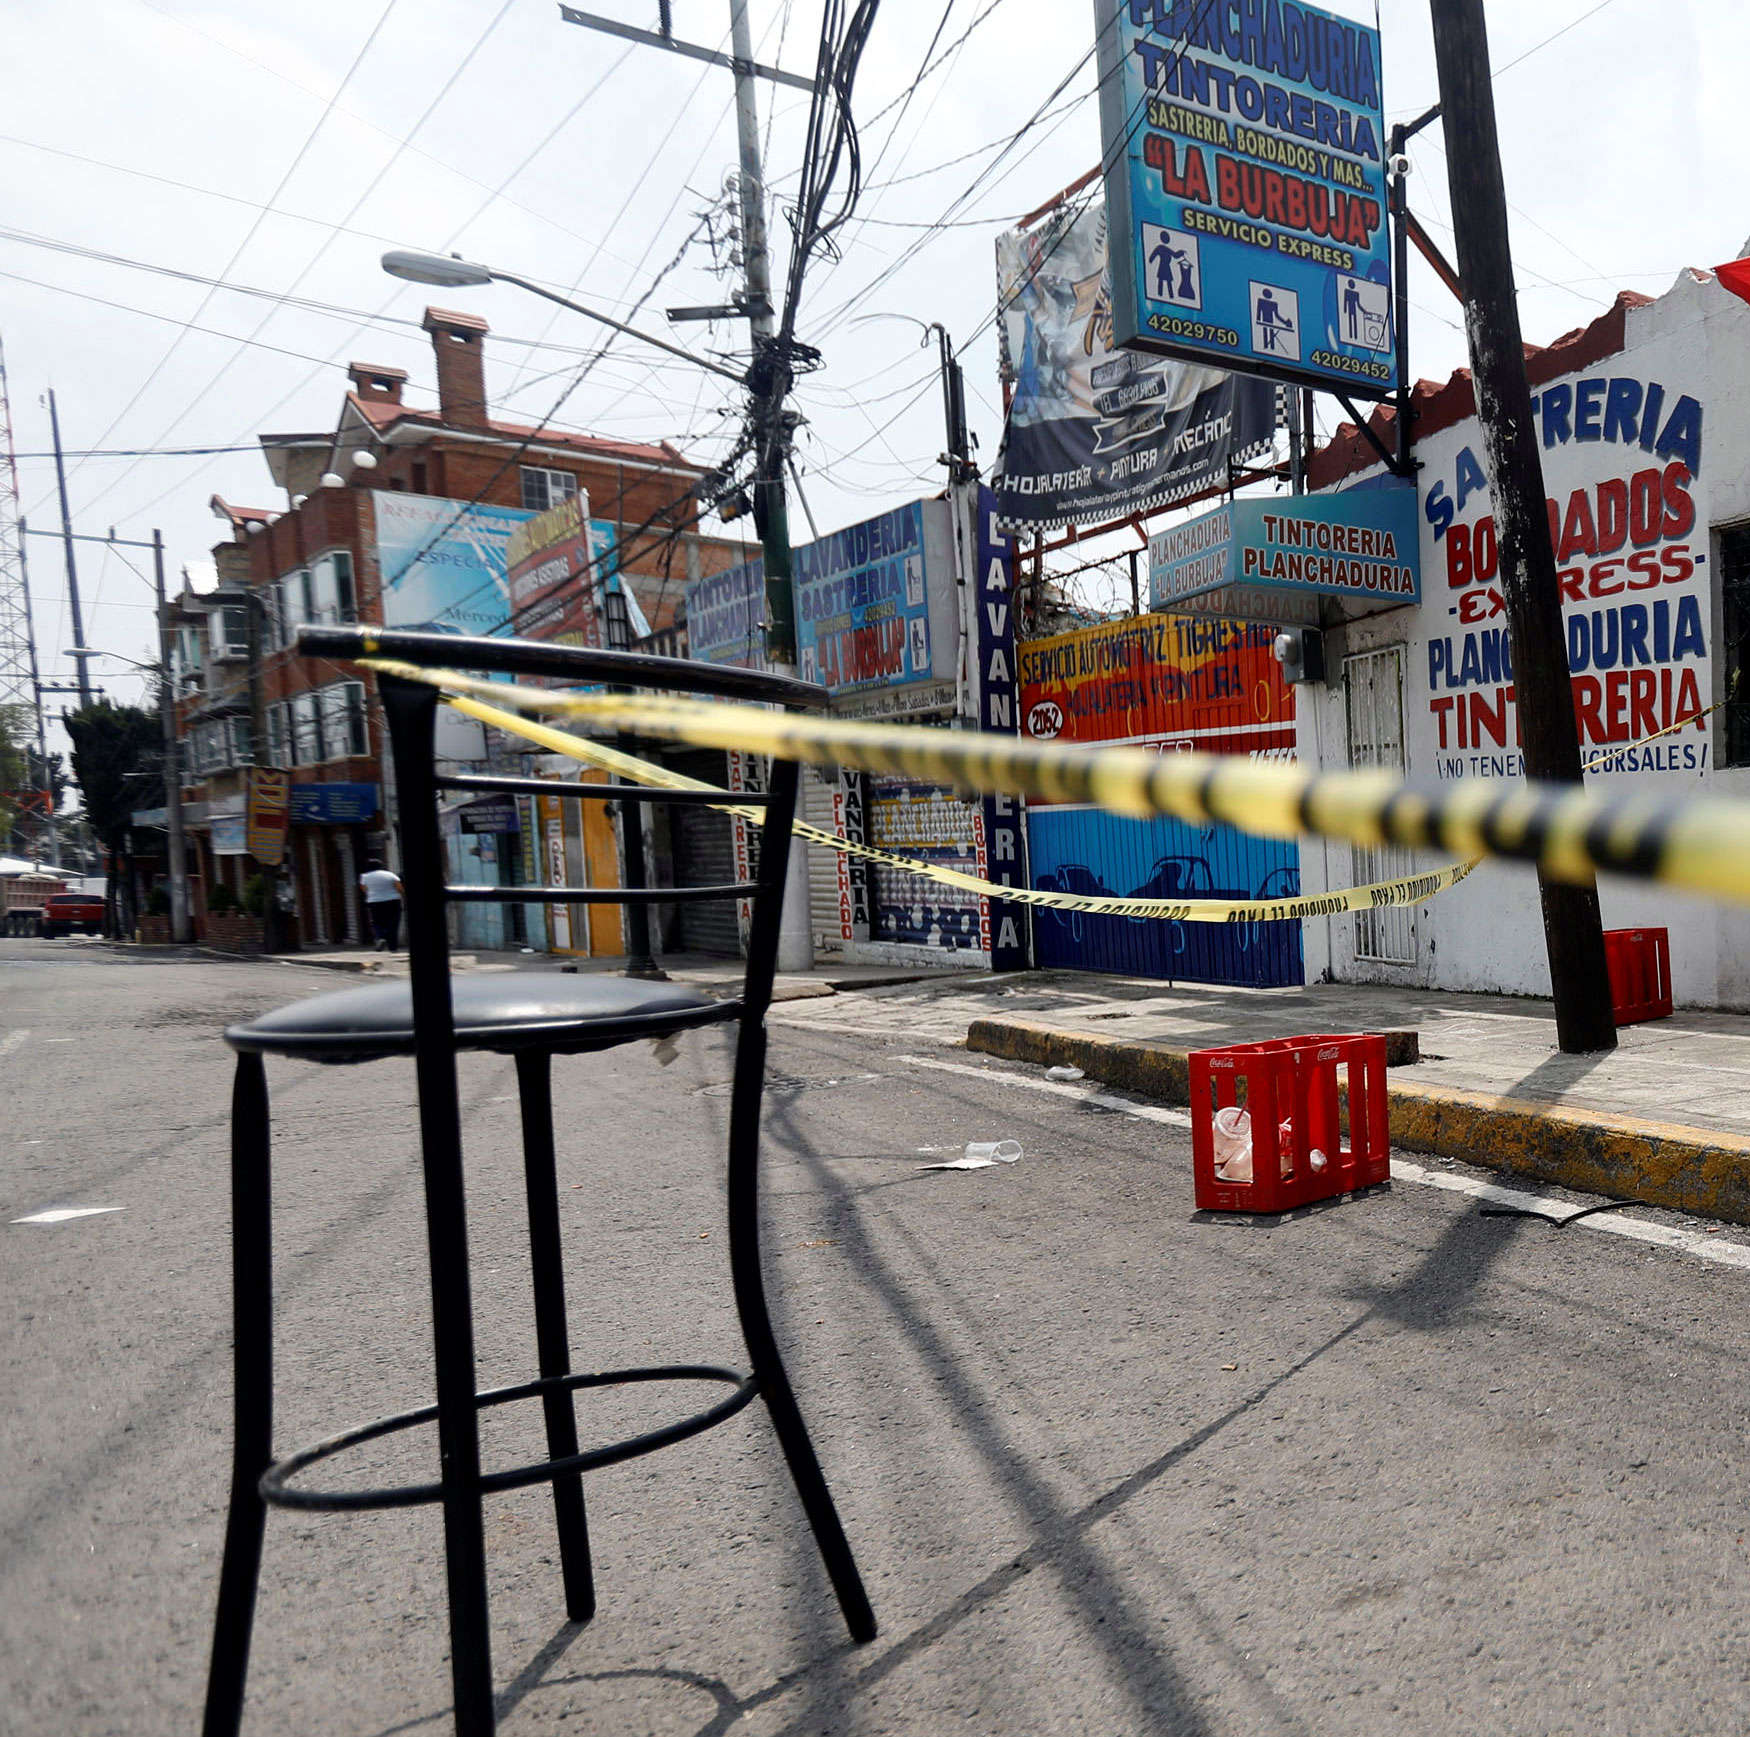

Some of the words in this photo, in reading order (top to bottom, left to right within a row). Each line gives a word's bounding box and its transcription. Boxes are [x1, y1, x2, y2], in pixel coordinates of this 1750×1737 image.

[1134, 39, 1379, 161] TINTORERIA
[1148, 101, 1232, 149] SASTRERIA,
[1236, 127, 1316, 174] BORDADOS
[1319, 156, 1331, 180] Y
[1184, 209, 1272, 249] SERVICIO
[1277, 231, 1353, 271] EXPRESS
[1148, 314, 1238, 347] 42029750
[1311, 349, 1389, 381] 42029452
[1110, 448, 1159, 480] PINTURA
[1425, 377, 1703, 543] SARERIA
[799, 503, 918, 584] LAVANDERIA
[1152, 511, 1231, 568] PLANCHADURIA
[1263, 515, 1398, 560] TINTORERIA
[1446, 462, 1696, 589] BOADOS
[801, 561, 900, 622] SASTRERIA
[1243, 548, 1415, 595] PLANCHADURIA
[1022, 643, 1076, 685] SERVICIO
[1079, 622, 1167, 676] AUTOMOTRIZ
[1428, 595, 1707, 690] PLANCDURIA
[1164, 665, 1244, 704] PINTURA
[1430, 668, 1707, 750] TINTRERIA
[986, 511, 1019, 948] LAVANERIA
